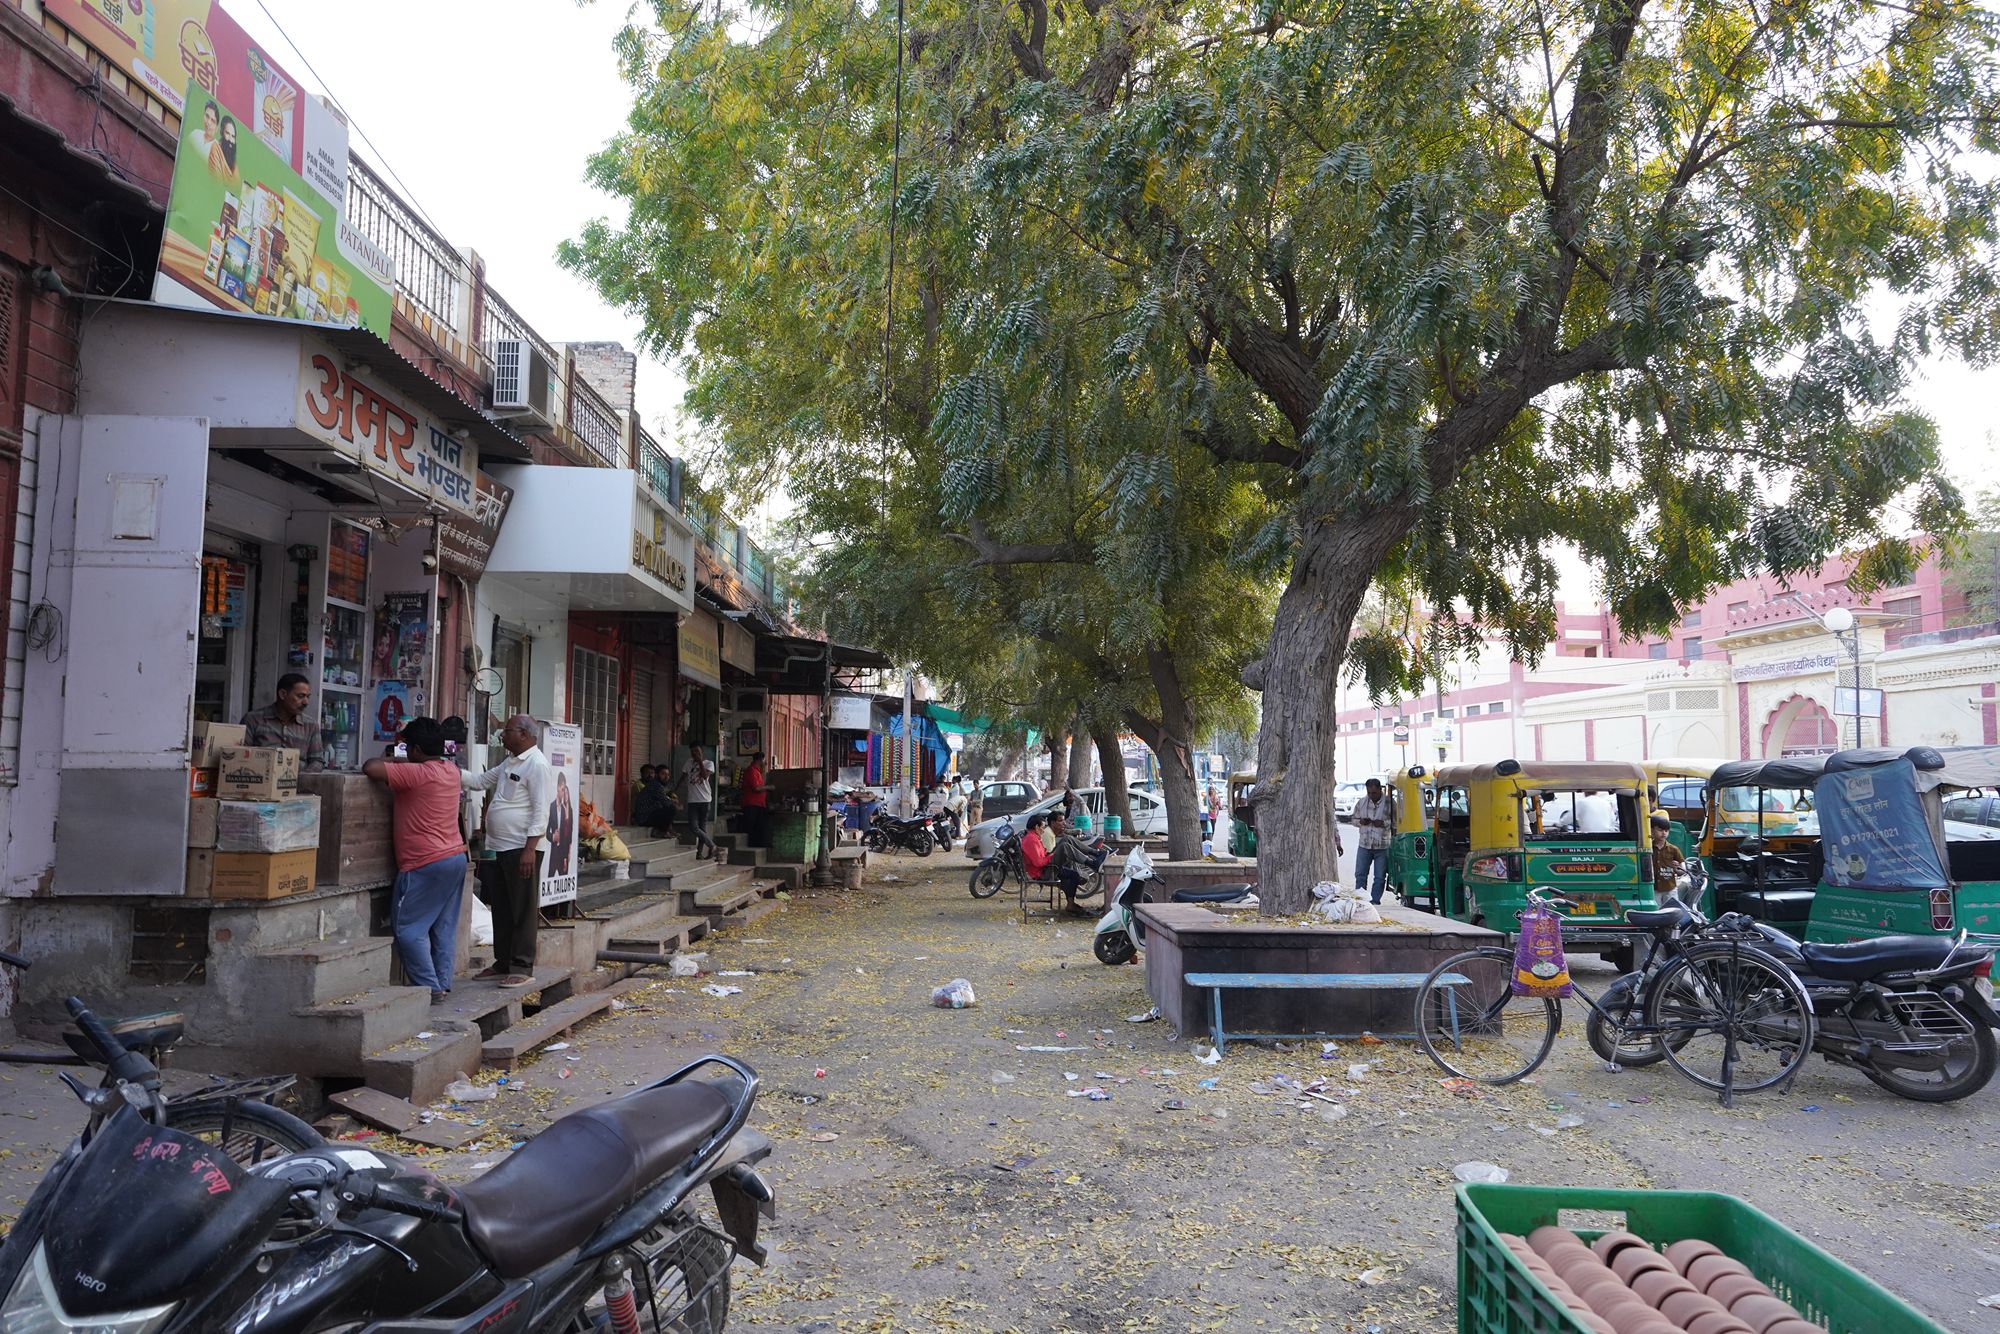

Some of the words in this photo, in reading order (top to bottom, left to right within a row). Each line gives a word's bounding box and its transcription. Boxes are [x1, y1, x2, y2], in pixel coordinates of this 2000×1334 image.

[144, 70, 160, 89] पहले
[306, 151, 318, 169] PAN
[318, 160, 345, 191] BHANDAR
[318, 147, 335, 169] AMAR
[340, 223, 390, 279] PATANJALI
[304, 354, 419, 477] अमर
[429, 425, 464, 469] पान
[416, 451, 472, 505] भण्डार
[553, 875, 576, 895] TAILOR'S
[75, 1271, 107, 1292] Hero
